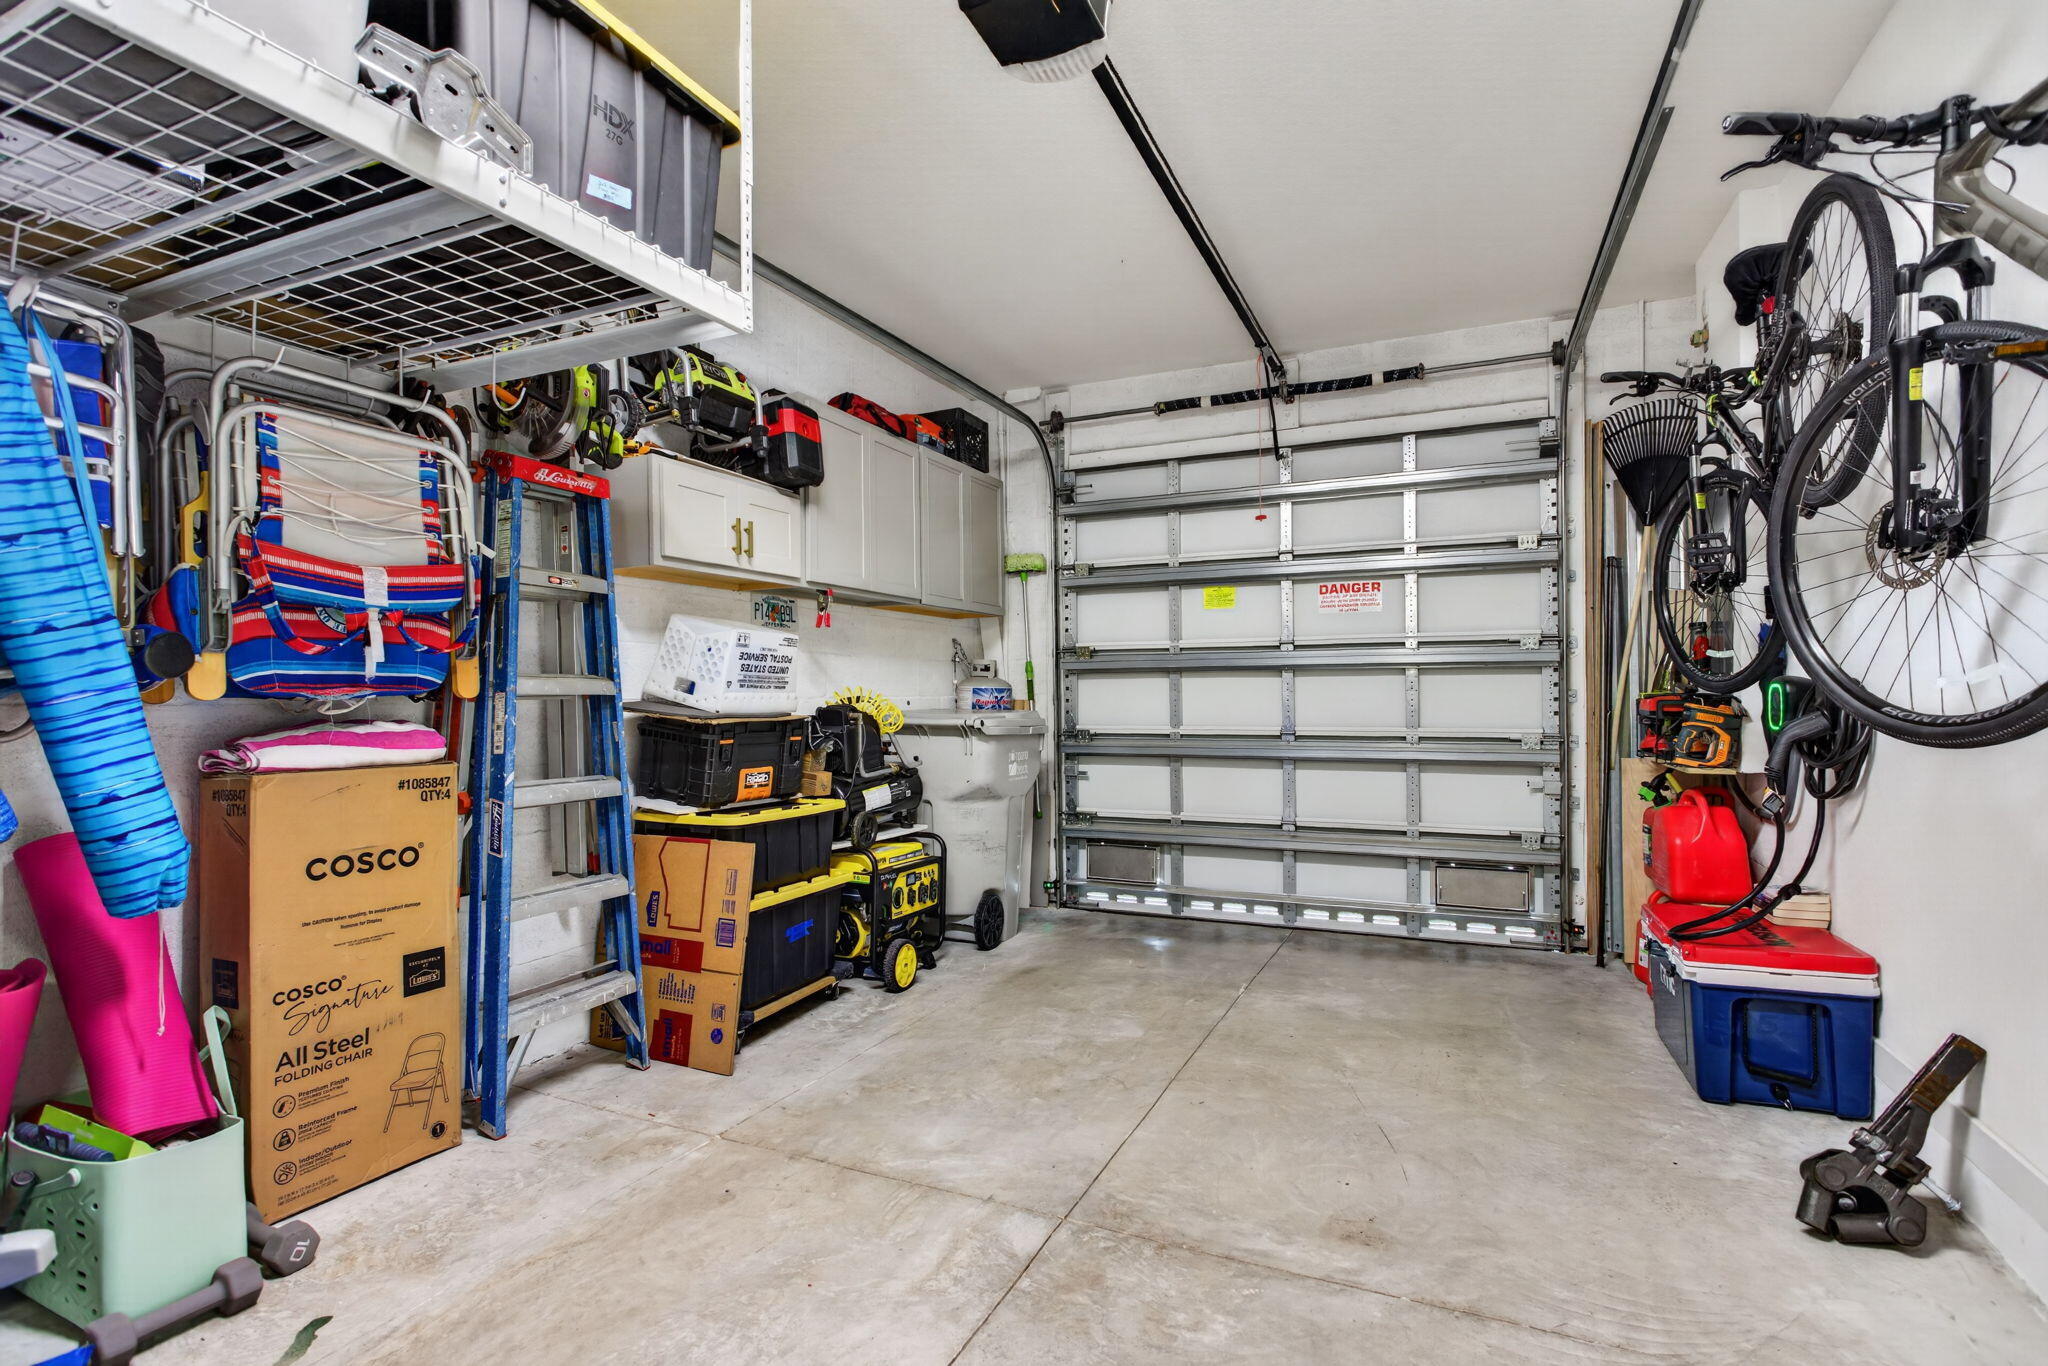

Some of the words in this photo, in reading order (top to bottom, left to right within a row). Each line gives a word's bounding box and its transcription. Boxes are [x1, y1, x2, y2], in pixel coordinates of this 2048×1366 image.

[593, 94, 634, 141] HDX
[605, 129, 623, 146] 27G
[1319, 582, 1381, 595] DANGER
[738, 651, 769, 663] SERVICE
[770, 654, 793, 664] POSTAL
[740, 663, 767, 673] STATES
[767, 665, 790, 674] UNITED
[1881, 693, 2032, 724] BONTRAGER
[398, 776, 451, 790] #1085847
[420, 789, 451, 802] QTY:4
[226, 804, 247, 817] QTY:4
[305, 845, 421, 882] COSCO
[272, 978, 343, 1006] COSCO
[283, 980, 394, 1036] Signature
[275, 1045, 307, 1073] All
[313, 1027, 370, 1060] Steel
[274, 1060, 333, 1087] FOLDING
[335, 1048, 373, 1066] CHAIR
[298, 1083, 329, 1098] Premium
[329, 1076, 350, 1089] Finish
[298, 1112, 336, 1130] Reinforced
[336, 1105, 358, 1117] Frame
